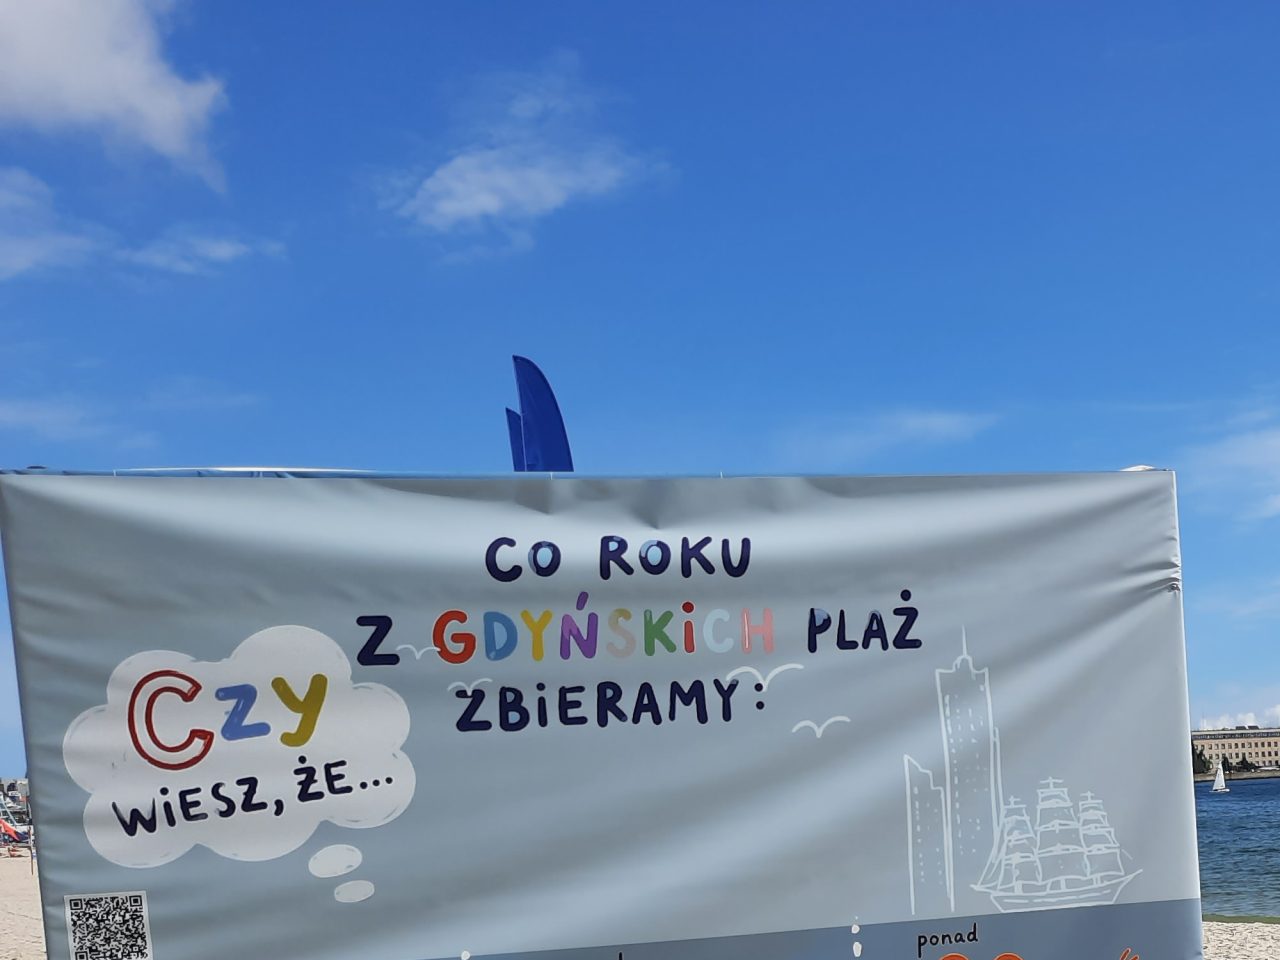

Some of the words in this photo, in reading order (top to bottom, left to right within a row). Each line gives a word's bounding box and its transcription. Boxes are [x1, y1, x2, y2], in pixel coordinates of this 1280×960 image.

[485, 536, 562, 583] CO
[599, 534, 752, 581] ROKU
[355, 614, 401, 666] Z
[807, 589, 923, 654] PLAŻ
[294, 754, 395, 805] ŻE...
[917, 923, 979, 959] ponad
